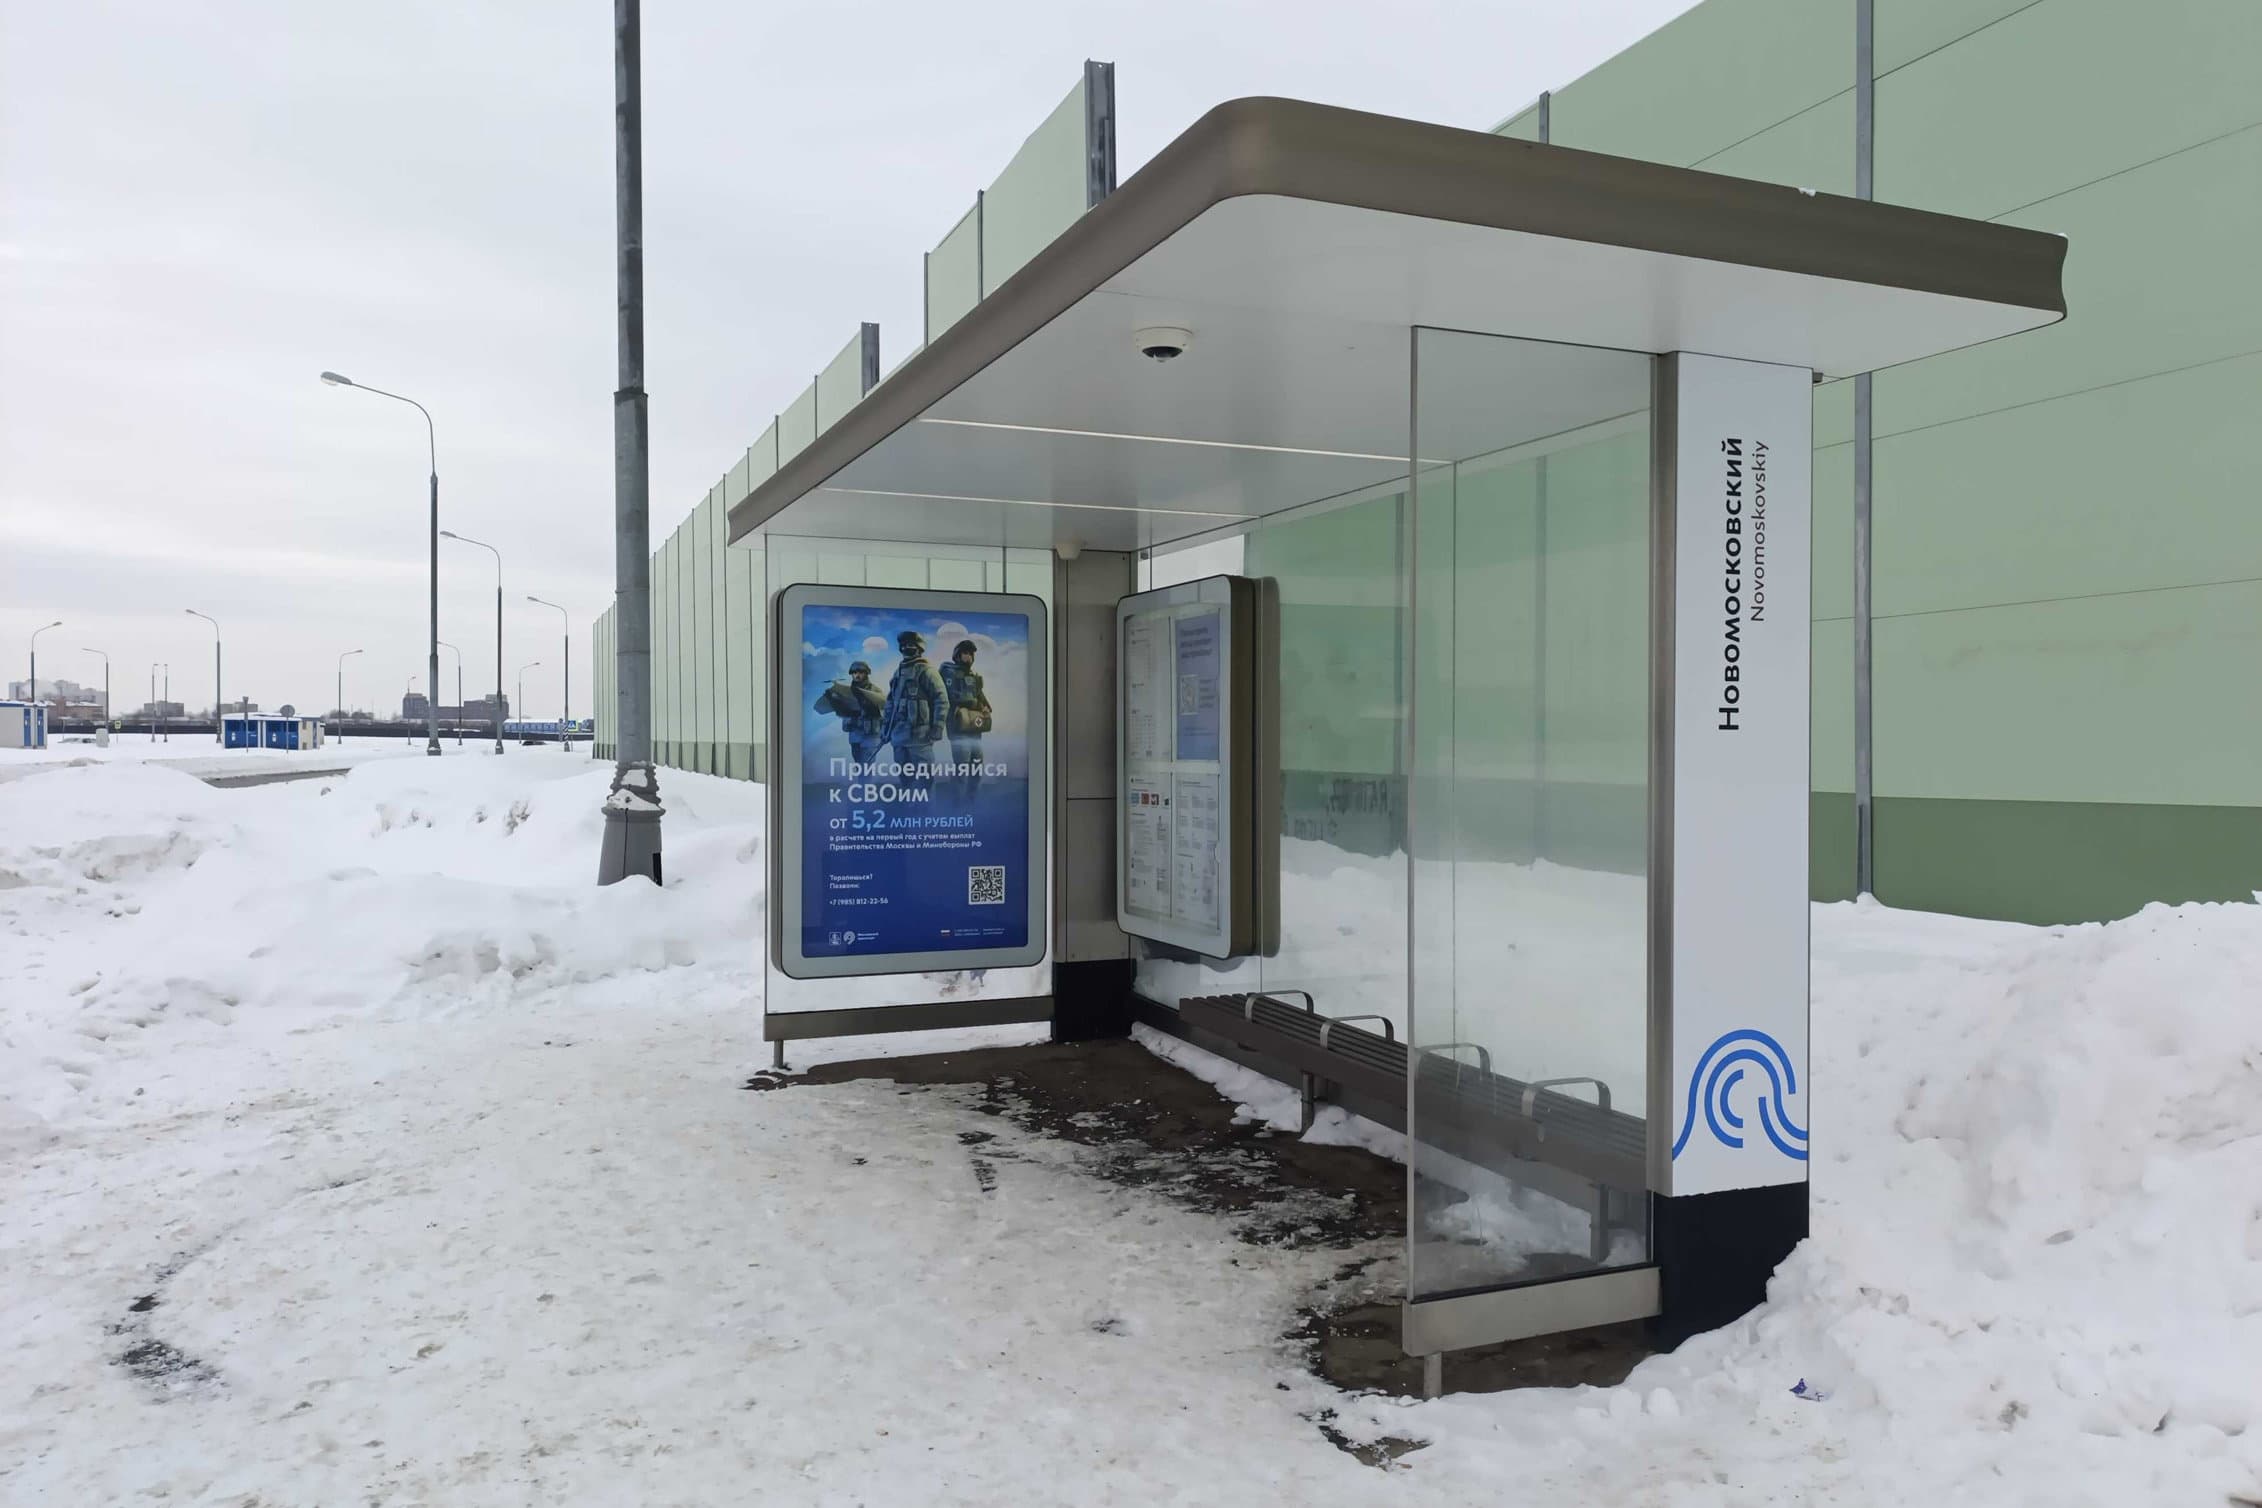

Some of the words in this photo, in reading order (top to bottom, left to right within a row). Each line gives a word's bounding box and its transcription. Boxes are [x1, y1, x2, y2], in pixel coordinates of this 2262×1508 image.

[1750, 441, 1769, 622] Novomoskovskiy
[1718, 438, 1742, 731] Новомосковский
[829, 757, 1008, 780] Присоединяйся
[829, 789, 842, 803] к
[847, 784, 929, 803] СВОим
[829, 818, 848, 829] от
[852, 809, 886, 832] 5,2
[924, 814, 974, 828] РУБЛЕЙ
[829, 843, 885, 851] Правительства
[922, 841, 970, 849] Минобороны
[971, 840, 982, 848] РФ
